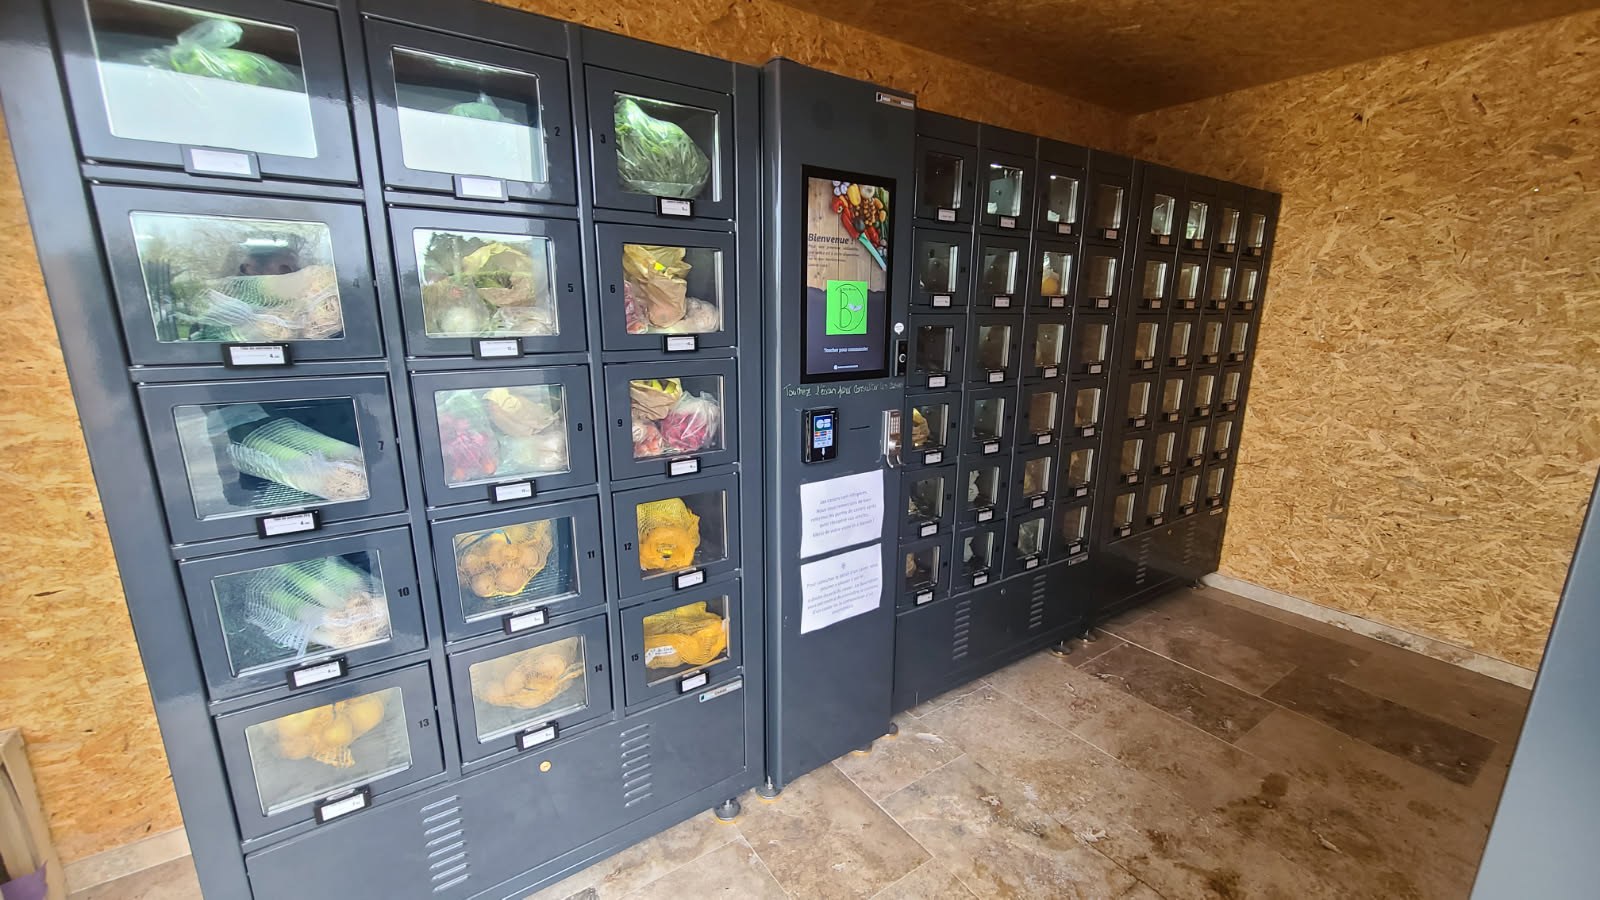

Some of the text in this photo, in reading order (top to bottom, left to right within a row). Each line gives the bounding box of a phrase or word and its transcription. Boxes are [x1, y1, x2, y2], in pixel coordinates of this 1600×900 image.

[554, 126, 560, 136] 2
[600, 133, 606, 144] 3
[808, 233, 849, 244] Bienvenue
[568, 283, 574, 292] 5
[609, 284, 616, 293] 6
[577, 422, 583, 431] 8
[617, 418, 623, 427] 9
[377, 441, 384, 450] 7
[624, 542, 632, 551] 12
[587, 550, 595, 559] 11
[397, 586, 410, 597] 10
[631, 653, 639, 662] 15
[594, 664, 602, 673] 14
[418, 718, 430, 728] 13
